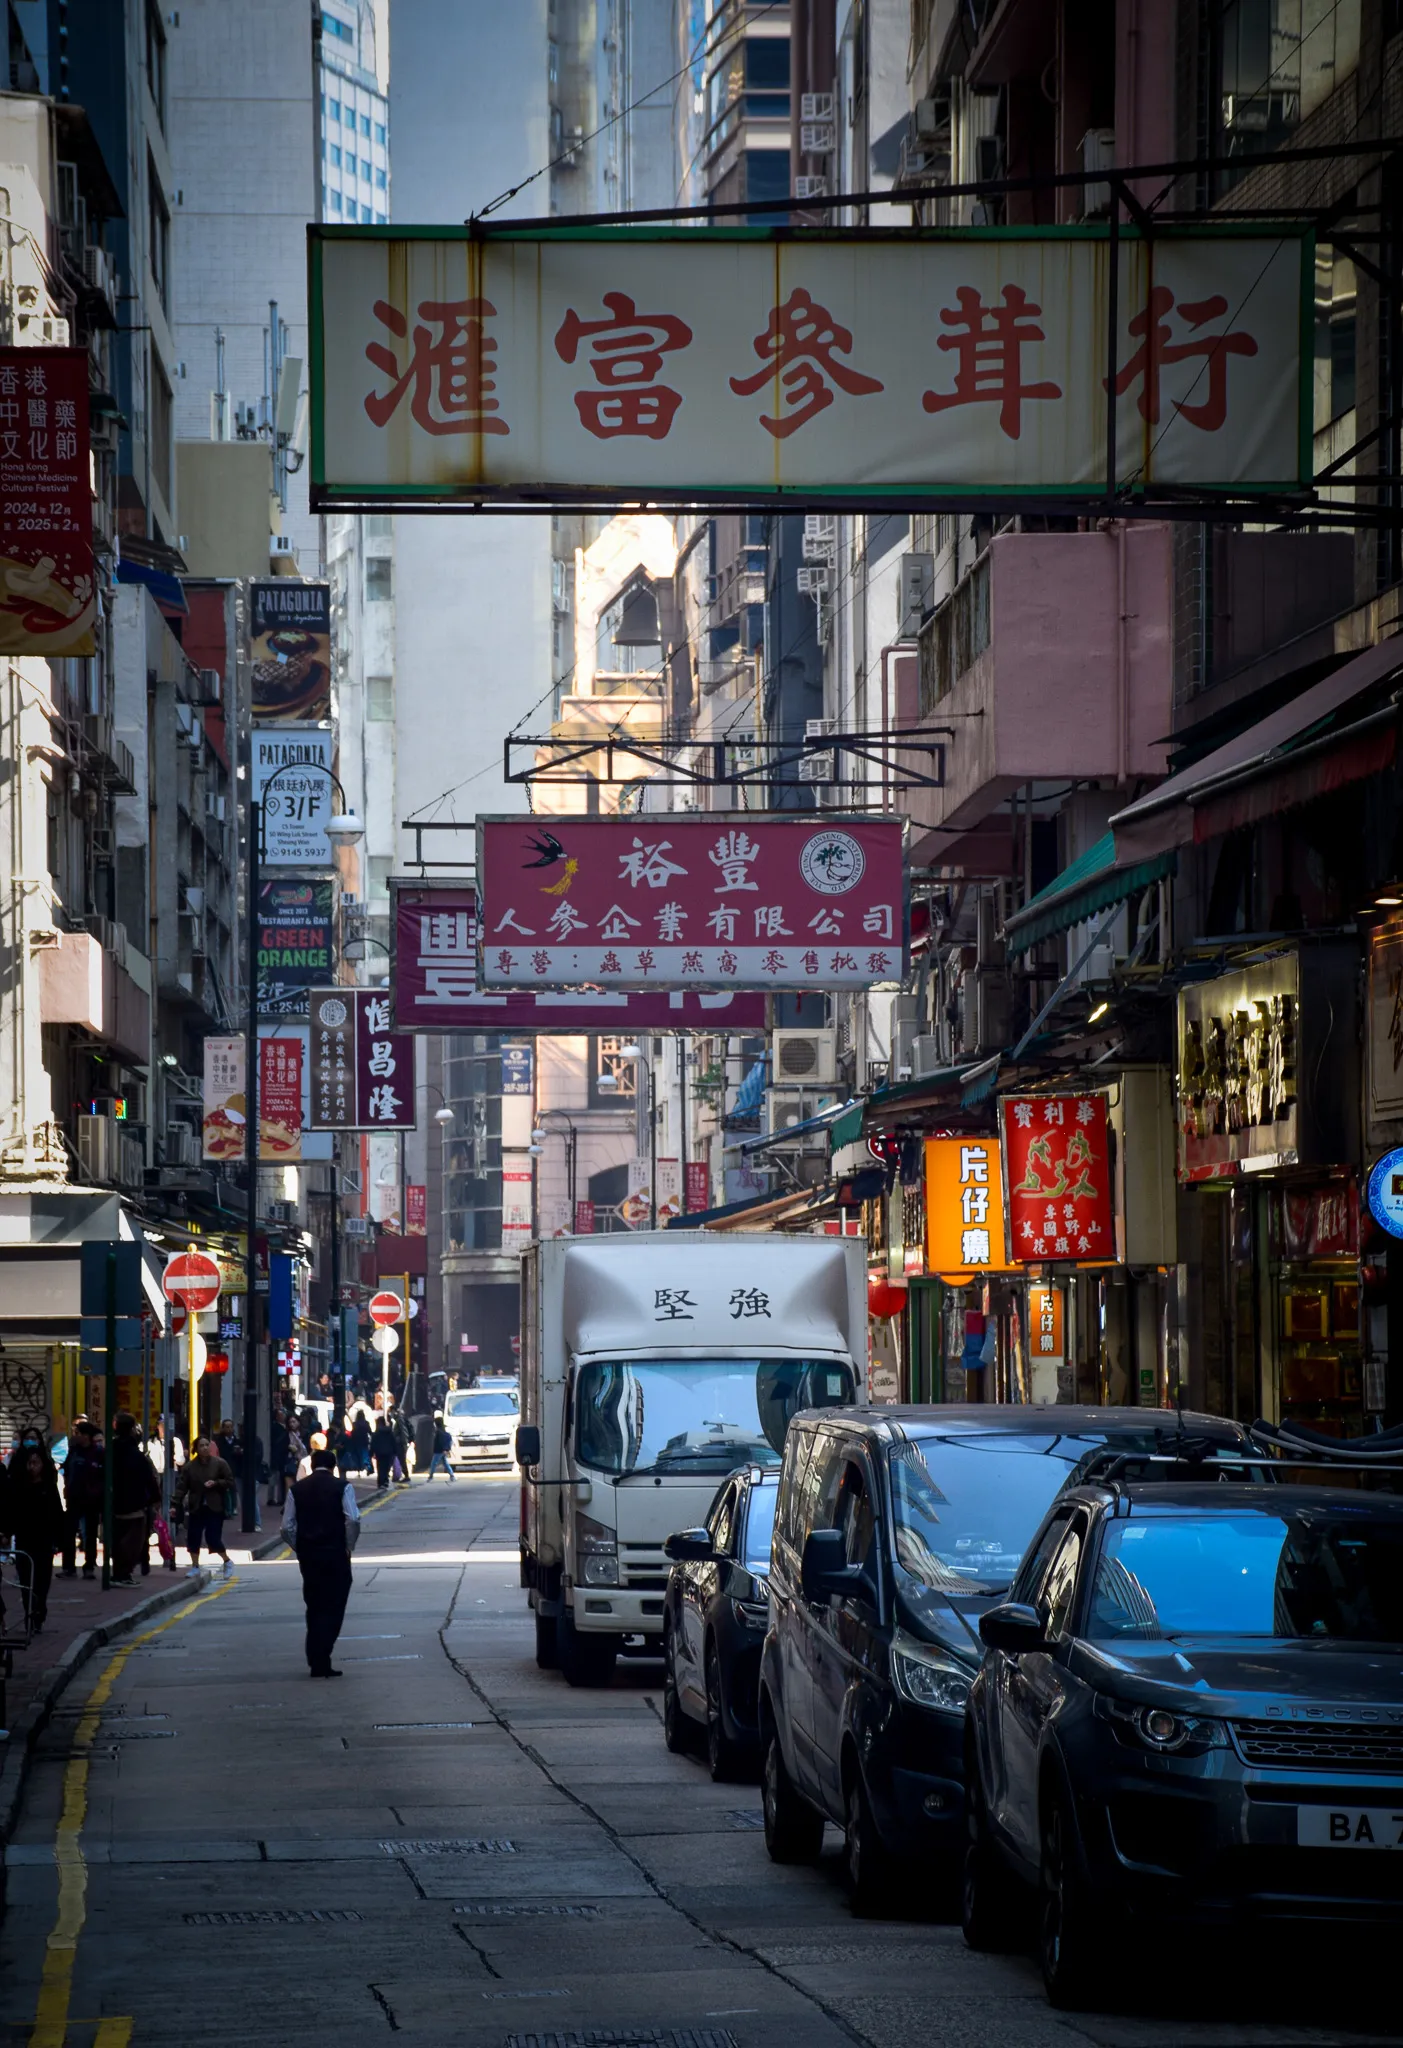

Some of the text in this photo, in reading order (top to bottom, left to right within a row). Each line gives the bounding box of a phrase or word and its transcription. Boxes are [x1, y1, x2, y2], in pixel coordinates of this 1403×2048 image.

[364, 283, 1258, 440] 滙富參茸行
[0, 365, 48, 395] 香港
[0, 398, 77, 428] 中醫藥
[1, 431, 77, 460] 文化節
[1, 463, 48, 472] Hong Kong
[1, 473, 78, 482] Chinese Medicine
[1, 483, 69, 492] Culture Festival
[258, 590, 324, 612] PATAGONIA
[259, 744, 325, 765] PATAGONIA
[284, 796, 321, 820] 3/F
[277, 831, 292, 839] Wing
[281, 848, 326, 857] 9145 5937
[618, 830, 760, 893] 裕豐
[810, 833, 842, 848] GINSENG
[846, 839, 862, 883] ENTERPRISE
[493, 900, 892, 942] 人參企業有限公司
[262, 928, 324, 948] GREEN
[257, 949, 328, 967] ORANGE
[1044, 1203, 1075, 1219] 專營
[1020, 1219, 1101, 1238] 美國野山
[1032, 1236, 1091, 1255] 花旗參
[654, 1287, 771, 1321] 堅強
[1330, 1813, 1375, 1843] BA
